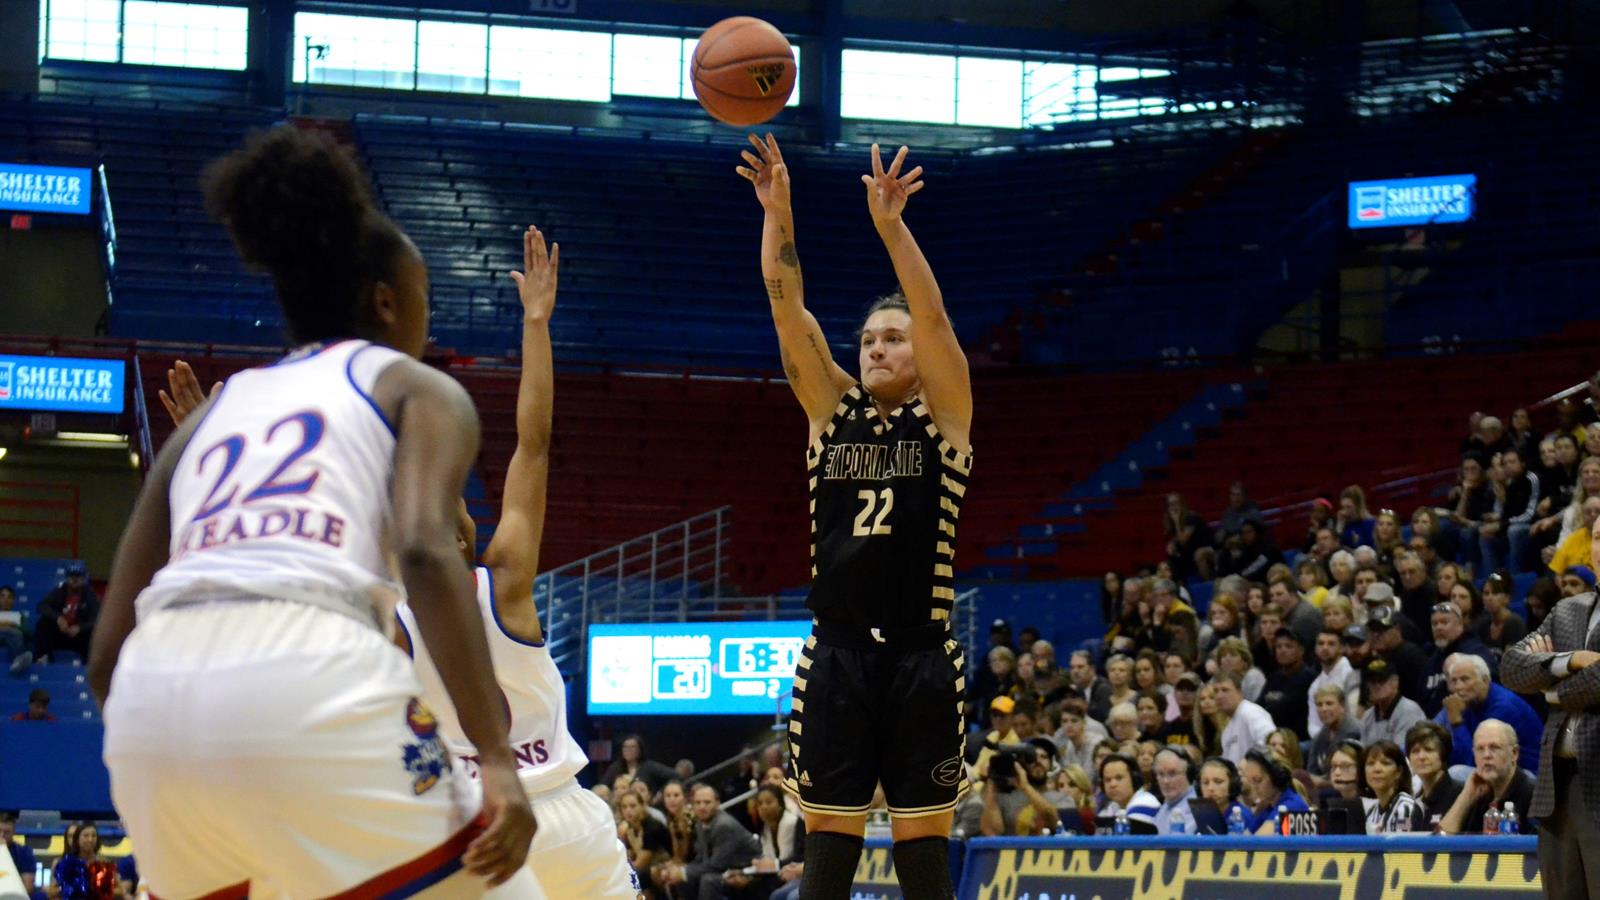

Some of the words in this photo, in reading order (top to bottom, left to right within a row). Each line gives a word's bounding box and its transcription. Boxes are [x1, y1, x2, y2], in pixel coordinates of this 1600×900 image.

[0, 172, 81, 192] SHELTER
[0, 188, 80, 206] NSURANCE
[1386, 184, 1466, 204] SHELTER
[16, 366, 113, 389] SHELTER
[16, 384, 112, 403] INSURANCE
[192, 409, 326, 523] 22
[852, 487, 894, 537] 22
[738, 643, 797, 673] 6:30
[673, 664, 704, 694] 20
[1289, 812, 1317, 836] POSS
